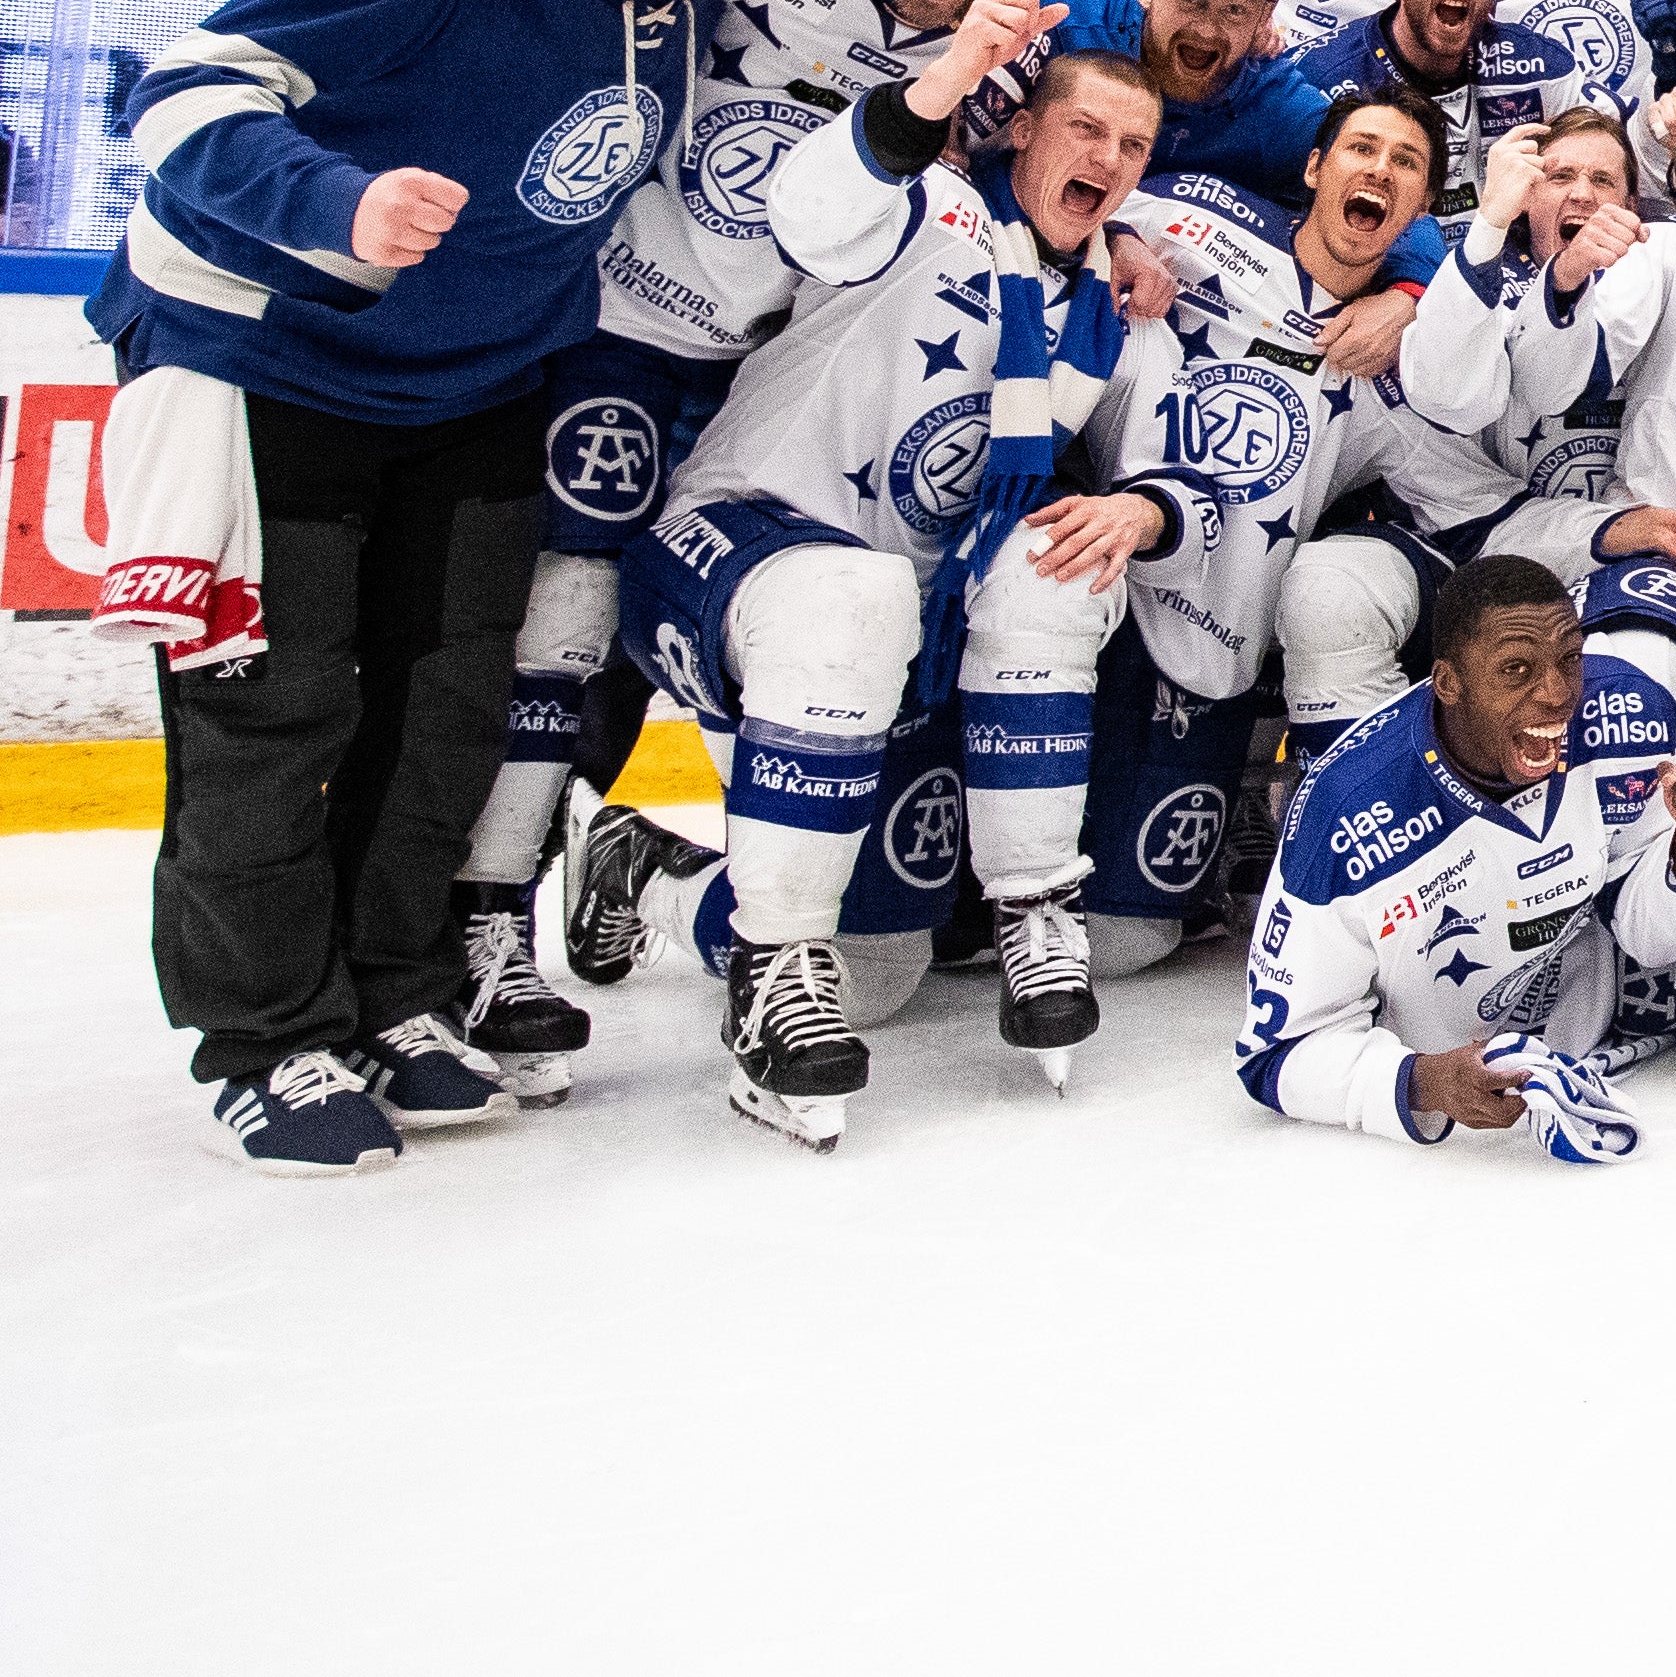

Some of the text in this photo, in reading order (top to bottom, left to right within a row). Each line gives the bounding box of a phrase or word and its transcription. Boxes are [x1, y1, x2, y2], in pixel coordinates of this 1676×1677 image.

[1296, 4, 1337, 28] CCM
[527, 107, 597, 185] LEKSANDS
[684, 103, 766, 168] LEKSANDS
[529, 187, 608, 220] ISHOCKEY
[686, 191, 767, 240] ISHOCKE
[1172, 181, 1265, 228] ohlson
[1203, 239, 1247, 279] Insjön
[1213, 229, 1269, 278] Bergkvist
[892, 398, 979, 475] LEKSANDS
[1230, 366, 1310, 490] IDROTTSFORENING
[995, 668, 1051, 680] CCM
[805, 706, 867, 721] CCM
[1296, 700, 1337, 711] CCM
[1583, 690, 1643, 720] clas
[994, 739, 1042, 754] KARL
[760, 770, 783, 789] AB
[785, 776, 837, 797] KARL
[1432, 763, 1486, 813] TEGERA
[1510, 788, 1544, 811] KLC
[1329, 796, 1394, 855] clas
[1346, 805, 1444, 882] ohlson
[1417, 849, 1476, 899] Bergkvist
[1520, 847, 1573, 876] CCM
[1422, 878, 1468, 914] Insjön
[1522, 876, 1590, 909] TEGERA
